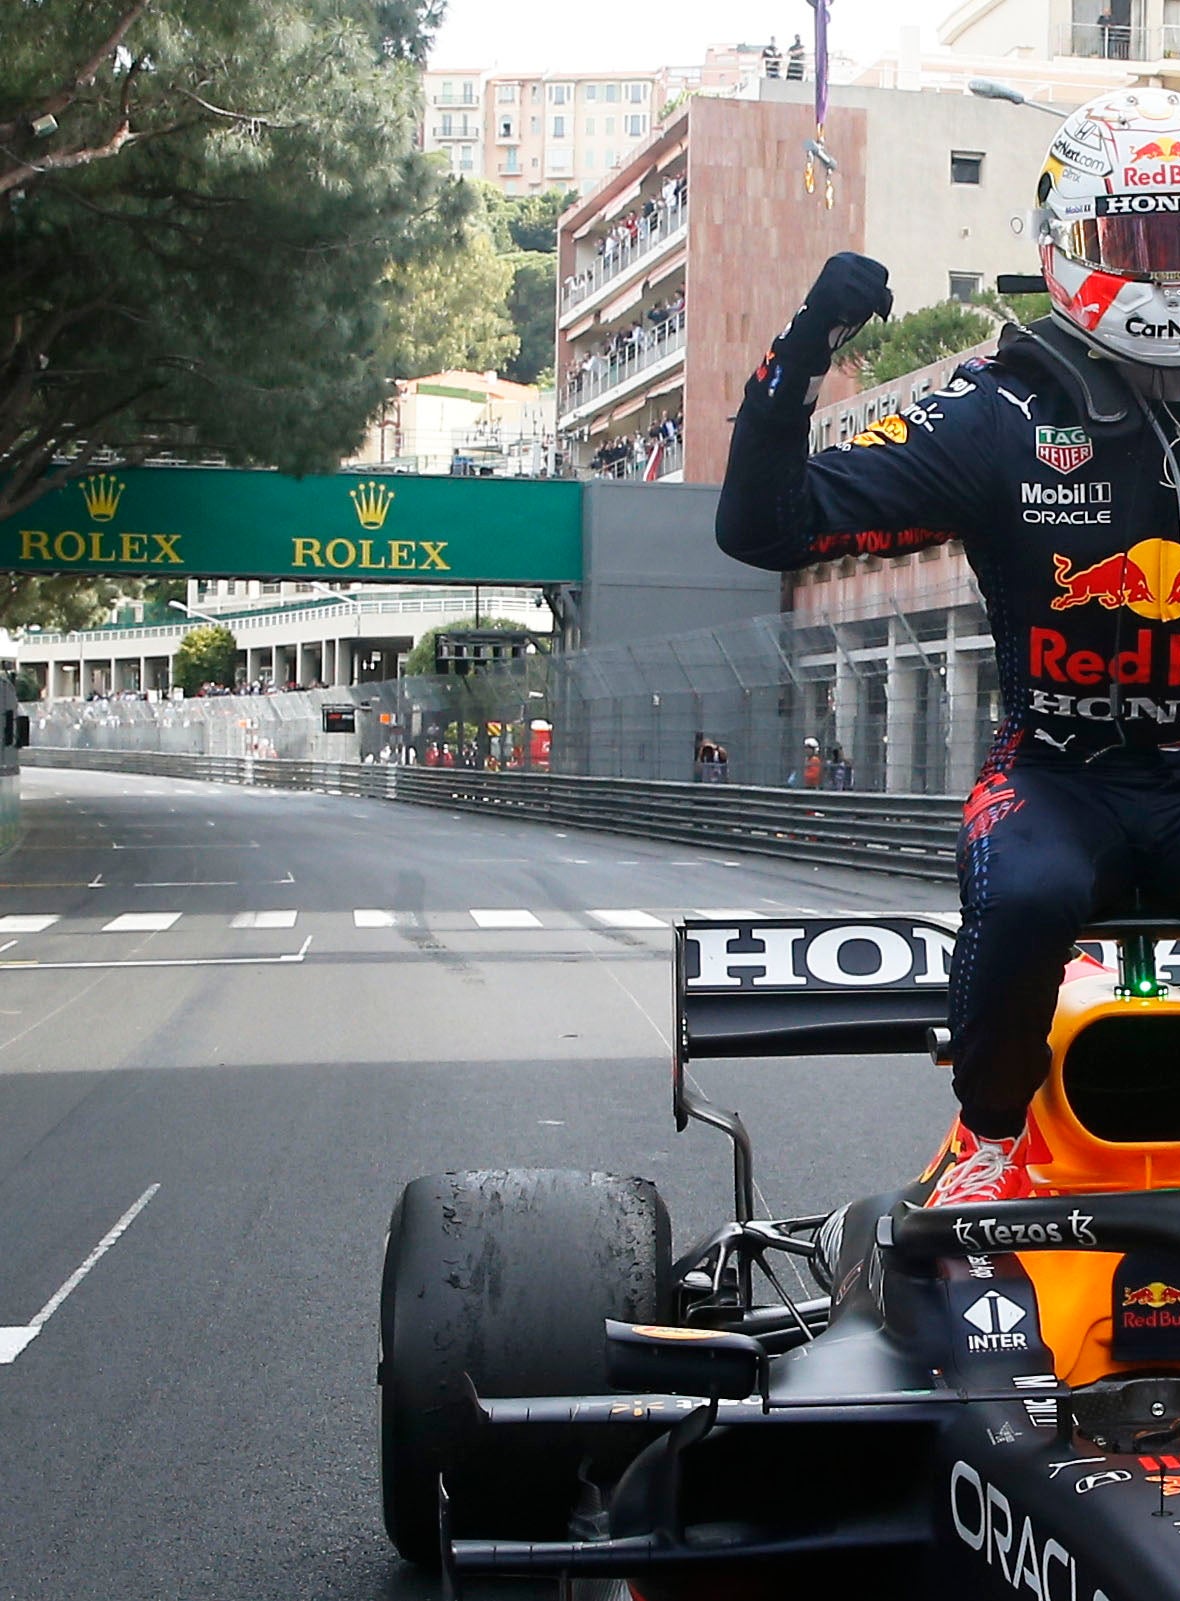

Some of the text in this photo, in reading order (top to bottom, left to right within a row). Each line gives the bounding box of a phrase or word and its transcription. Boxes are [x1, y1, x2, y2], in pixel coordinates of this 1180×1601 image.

[1124, 164, 1166, 186] Red
[1040, 430, 1086, 444] TAG
[1040, 447, 1089, 470] HEUER
[1021, 483, 1086, 505] Mobil
[1022, 509, 1112, 525] ORACLE
[19, 530, 184, 564] ROLEX
[292, 537, 451, 571] ROLEX
[1029, 625, 1153, 686] Red
[979, 1218, 1063, 1246] Tezos
[1123, 1311, 1157, 1328] Red
[968, 1333, 1027, 1350] INTER
